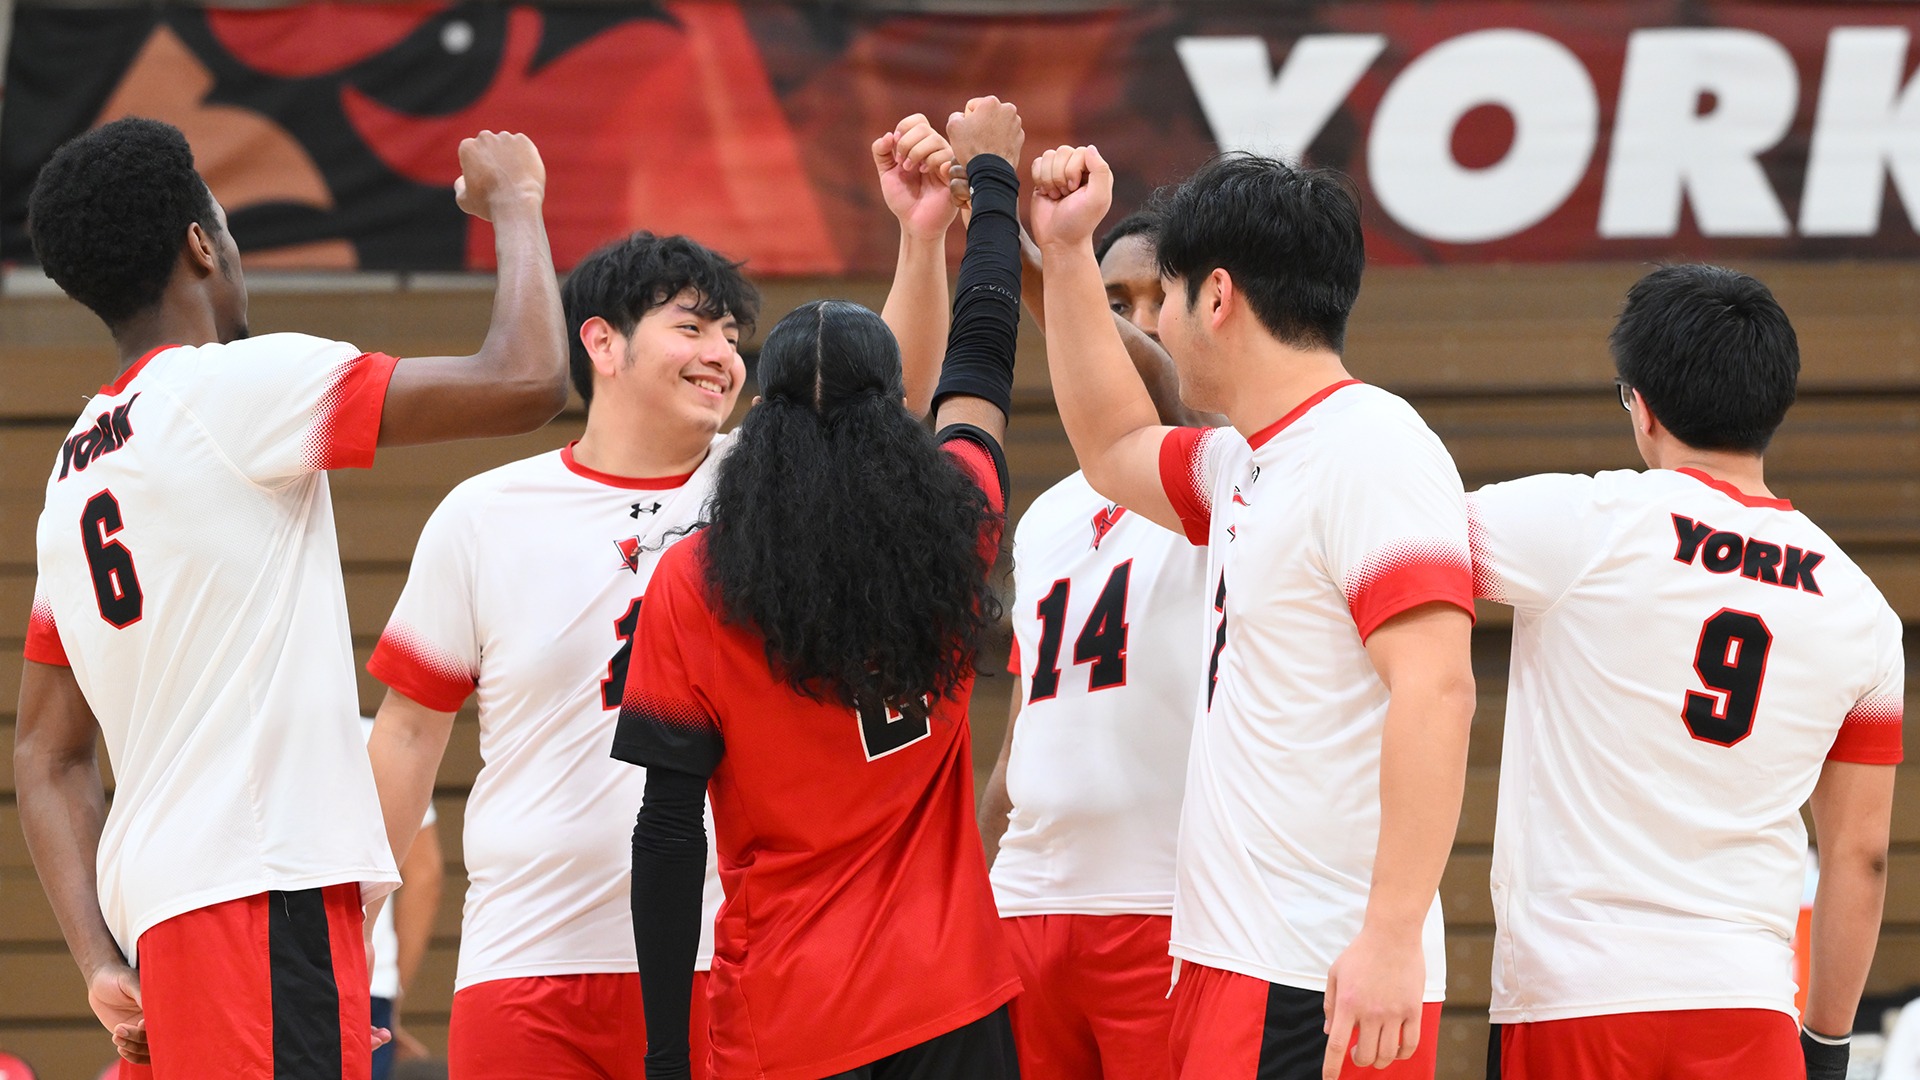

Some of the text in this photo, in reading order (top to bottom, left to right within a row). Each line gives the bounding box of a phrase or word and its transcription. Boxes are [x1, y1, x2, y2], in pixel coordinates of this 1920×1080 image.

[1174, 26, 1920, 244] YORK
[57, 391, 142, 482] YORK
[80, 488, 144, 630] 6
[1670, 512, 1825, 597] YORK
[1028, 558, 1134, 706] 14
[1680, 606, 1774, 748] 9
